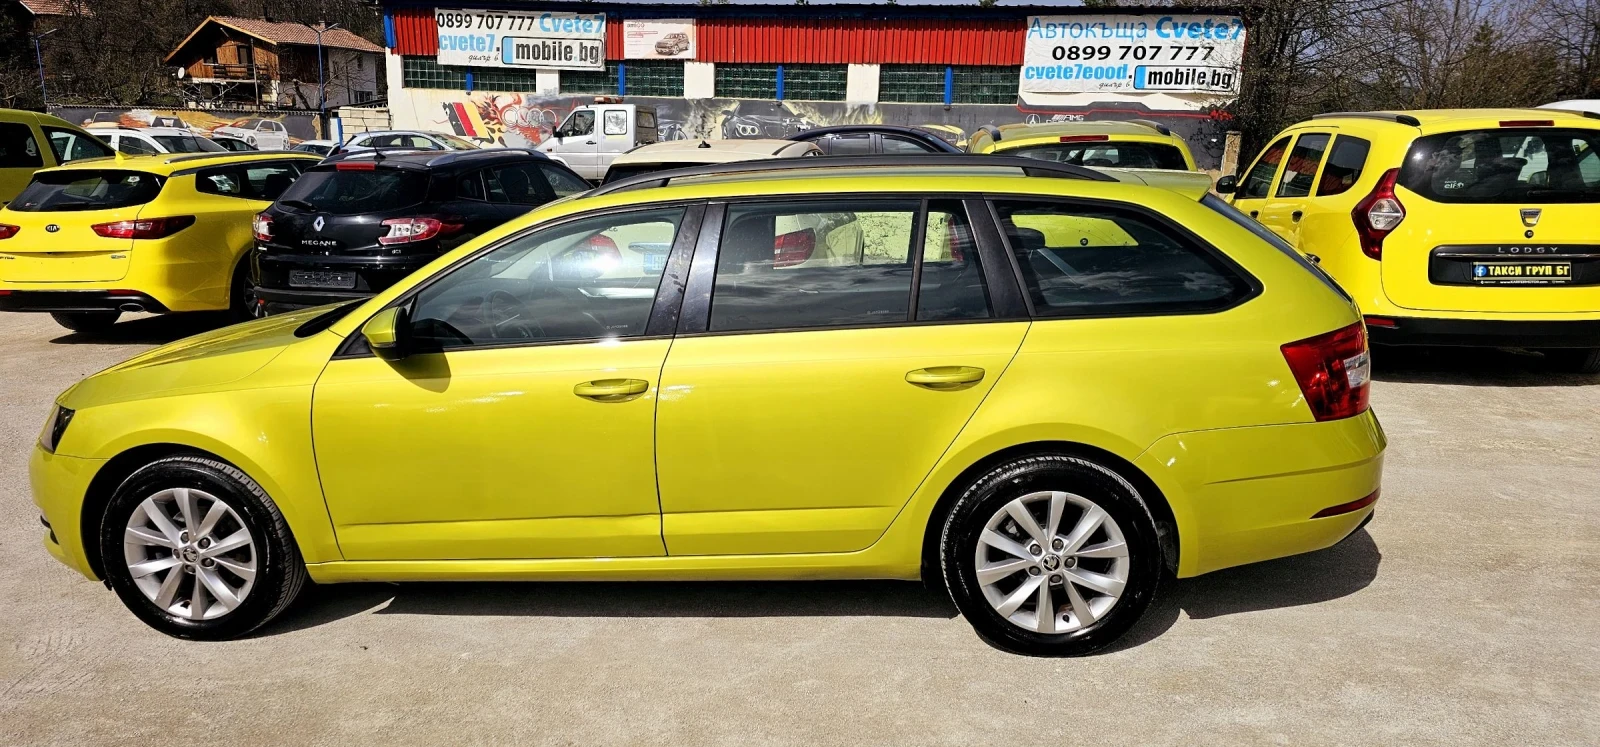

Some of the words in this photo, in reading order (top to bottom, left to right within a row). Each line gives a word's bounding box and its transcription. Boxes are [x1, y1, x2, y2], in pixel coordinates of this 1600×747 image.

[437, 12, 473, 28] 0899
[476, 14, 504, 30] 707
[507, 15, 535, 31] 777
[539, 12, 605, 33] Cvete7
[1028, 17, 1148, 42] Автокъща
[1155, 16, 1244, 39] Cvete7
[515, 40, 599, 64] mobile.bg
[1052, 45, 1111, 60] 0899
[1118, 45, 1162, 60] 707
[1169, 45, 1215, 60] 777
[1147, 68, 1232, 89] mobile.bg
[301, 239, 337, 247] MEGANE
[1498, 246, 1558, 254] LODGY
[1488, 265, 1522, 276] ТАКСИ
[1526, 265, 1552, 276] ГРУП
[1556, 265, 1570, 276] БГ
